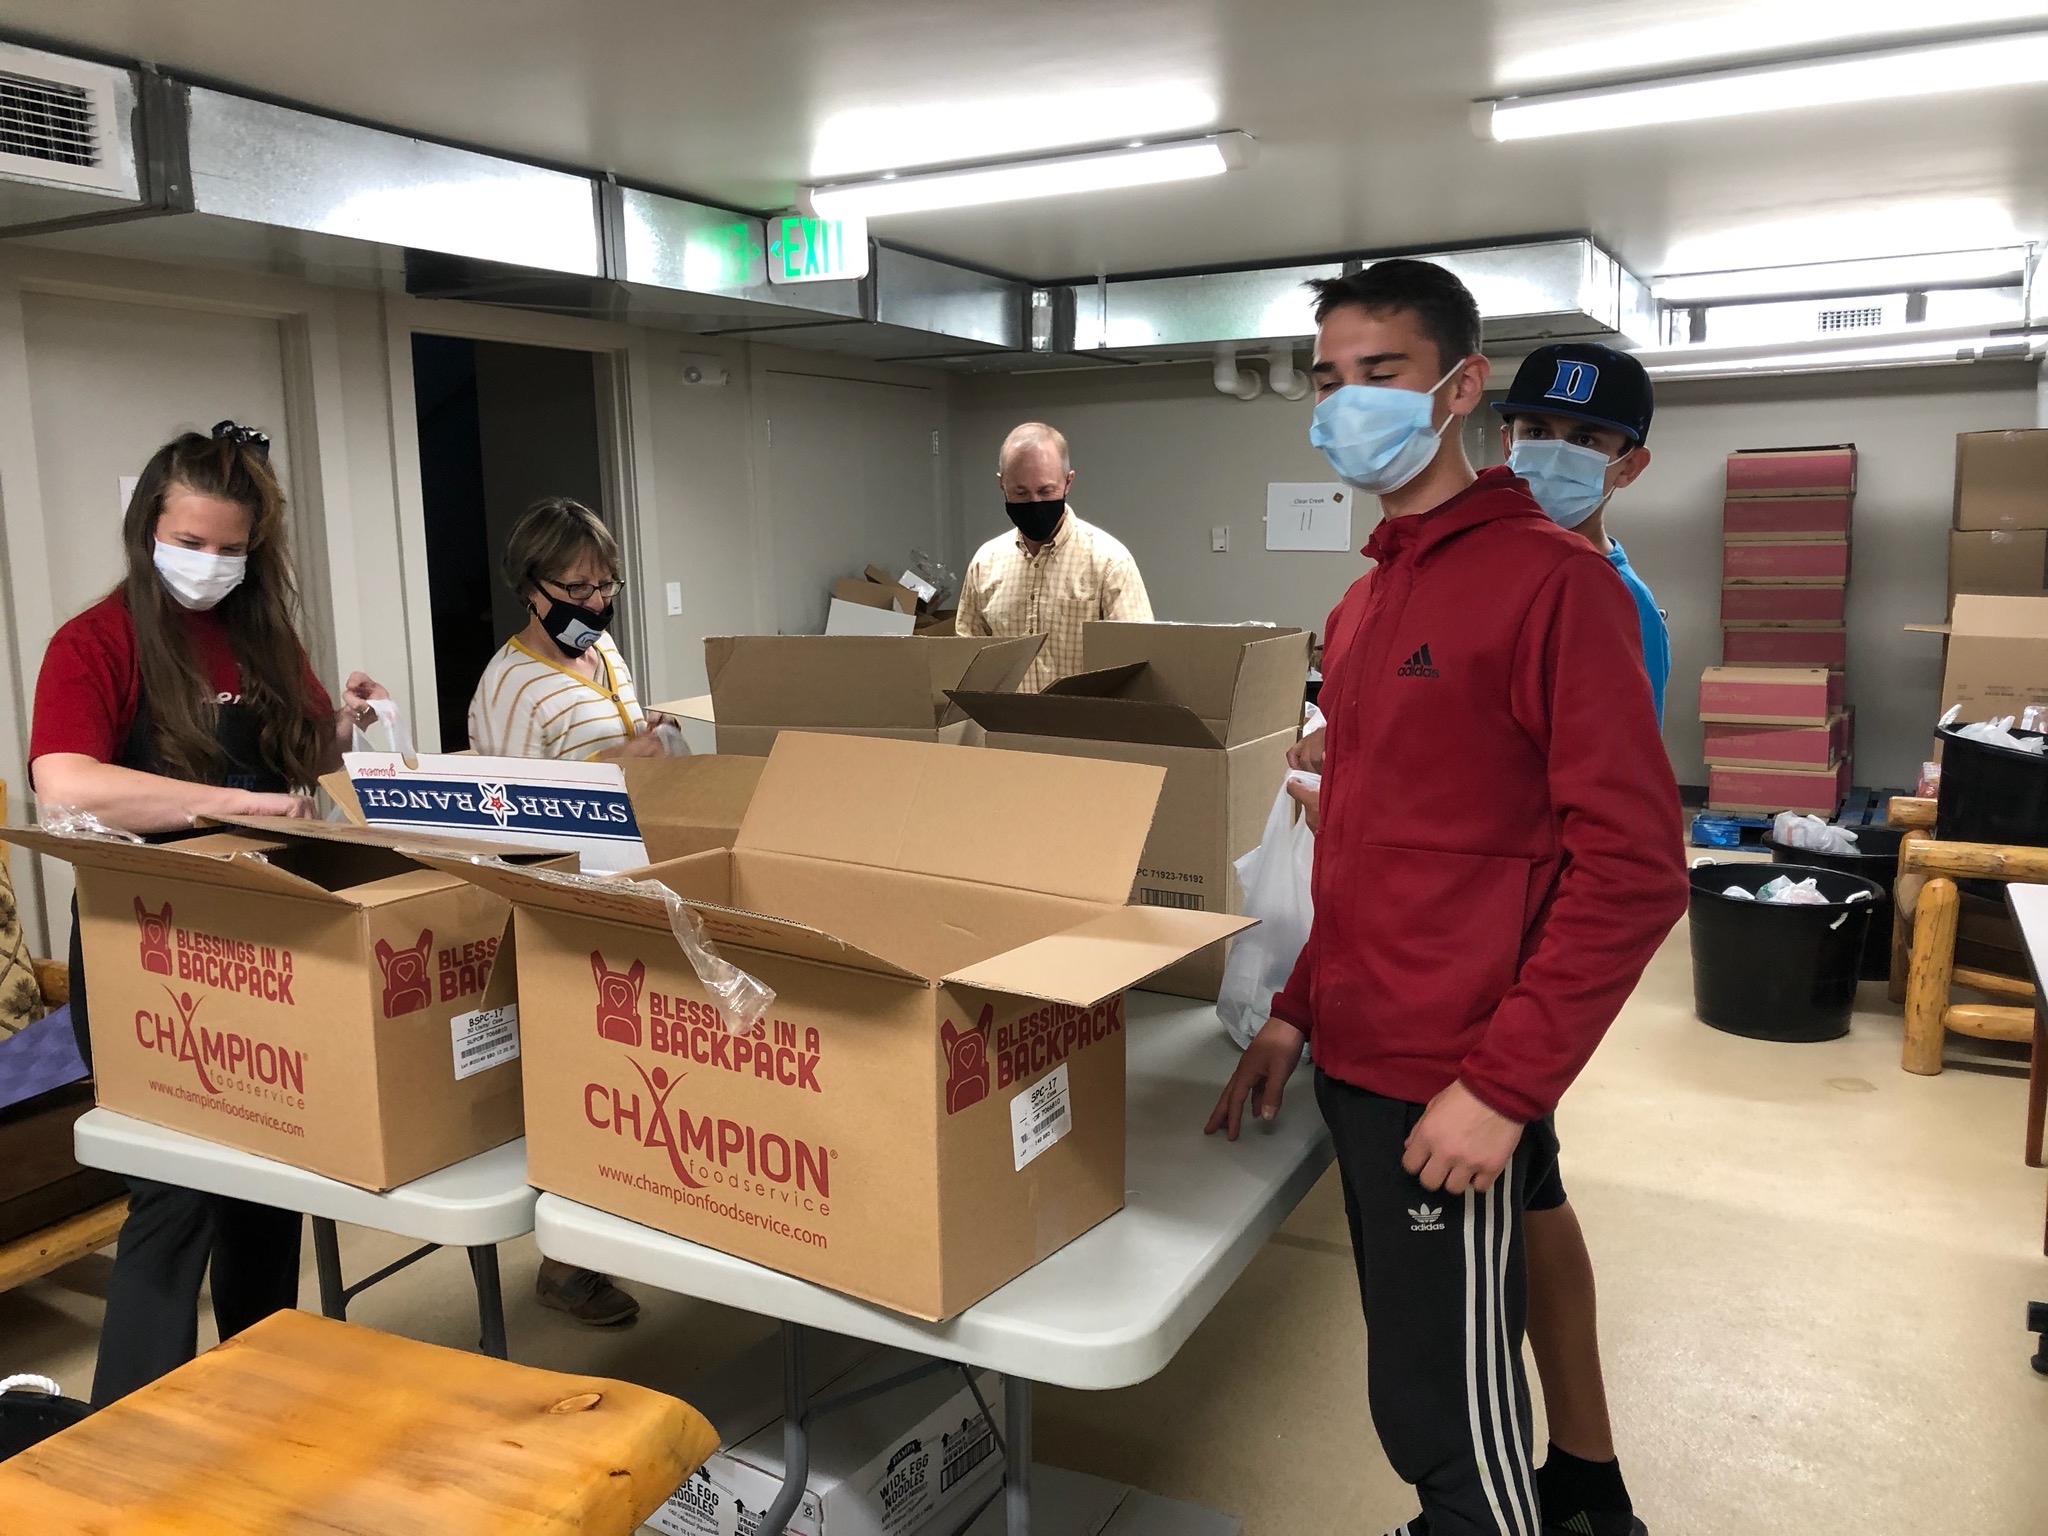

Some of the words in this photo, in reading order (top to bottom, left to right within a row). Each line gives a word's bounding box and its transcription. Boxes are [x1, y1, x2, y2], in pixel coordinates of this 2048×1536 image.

[1544, 360, 1599, 404] D
[1397, 665, 1440, 679] adidas
[358, 763, 396, 778] growers
[364, 788, 477, 811] RANCH
[516, 795, 628, 823] STARR
[1136, 868, 1148, 876] PC
[1150, 870, 1204, 884] 71923-76192
[176, 928, 256, 965] BLESSINGS
[261, 946, 276, 969] IN
[282, 951, 293, 973] A
[438, 936, 500, 971] BLESS
[177, 950, 294, 1005] BACKPACK
[469, 1008, 504, 1028] BSPC-17
[650, 992, 766, 1041] BLESSIS
[774, 1020, 796, 1048] IN
[805, 1026, 820, 1054] A
[650, 1016, 822, 1093] BACKPACK
[998, 998, 1122, 1090] BACKPACK
[148, 1080, 304, 1138] www.championfoodservice.com
[210, 1070, 306, 1110] foodservice
[1031, 1077, 1057, 1104] SPC-17
[598, 1164, 827, 1249] www.championfoodservice.com
[689, 1160, 830, 1216] foodservice
[1410, 1223, 1446, 1232] adidas
[698, 1484, 720, 1506] EGG
[880, 1467, 907, 1500] WIDE
[910, 1454, 929, 1476] EGG
[884, 1470, 925, 1510] NOODLES
